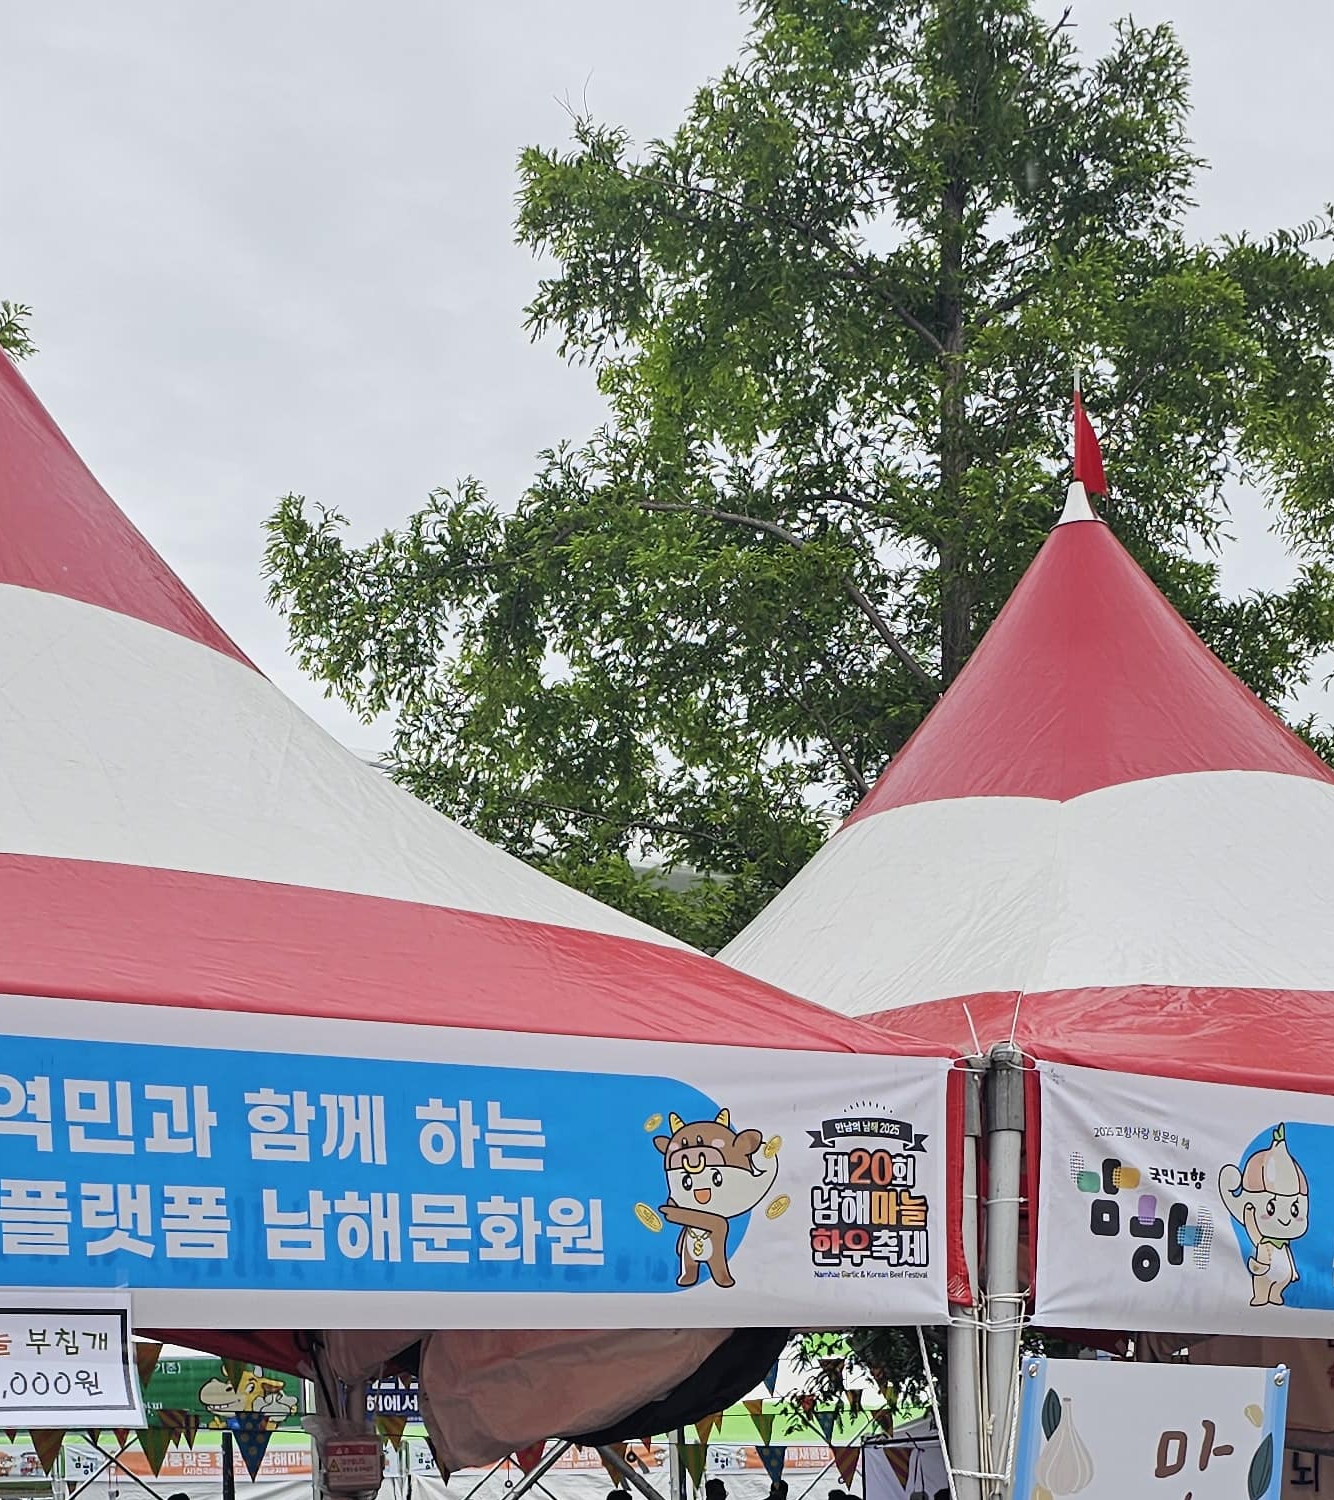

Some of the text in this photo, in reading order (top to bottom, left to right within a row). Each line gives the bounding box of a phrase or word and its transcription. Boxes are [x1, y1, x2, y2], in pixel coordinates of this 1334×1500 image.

[244, 1087, 386, 1166] 함께
[415, 1097, 547, 1172] 하는
[834, 1121, 901, 1136] 만남의 남해 2025
[1115, 1126, 1150, 1139] 고향사랑
[1152, 1129, 1179, 1147] 방문의
[824, 1149, 915, 1187] 제20회
[1149, 1166, 1206, 1190] 국민고향
[812, 1188, 928, 1226] 남해마늘
[263, 1189, 606, 1267] 남해문화원
[812, 1228, 928, 1266] 한우축제
[25, 1327, 110, 1356] 부침개
[1290, 1452, 1320, 1492] 뇌
